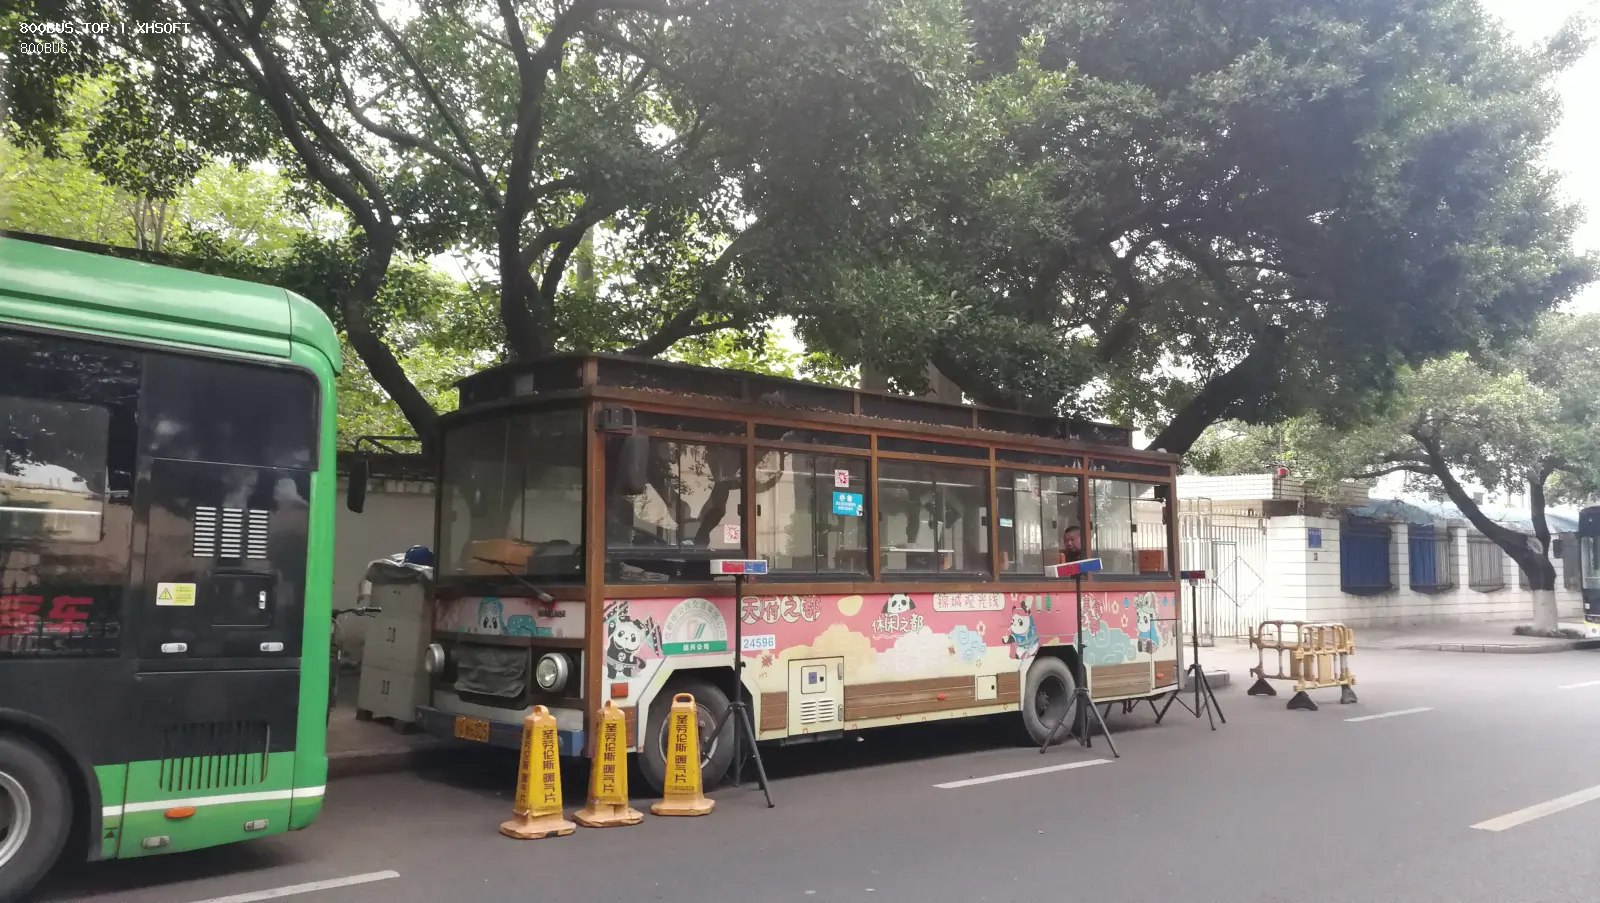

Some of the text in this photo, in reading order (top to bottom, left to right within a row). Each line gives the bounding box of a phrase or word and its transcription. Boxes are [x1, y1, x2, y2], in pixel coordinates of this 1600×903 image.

[741, 595, 822, 623] 天府之都
[937, 593, 999, 609] 锦城观光线
[872, 613, 924, 634] 休闲之都
[743, 638, 774, 649] 24596
